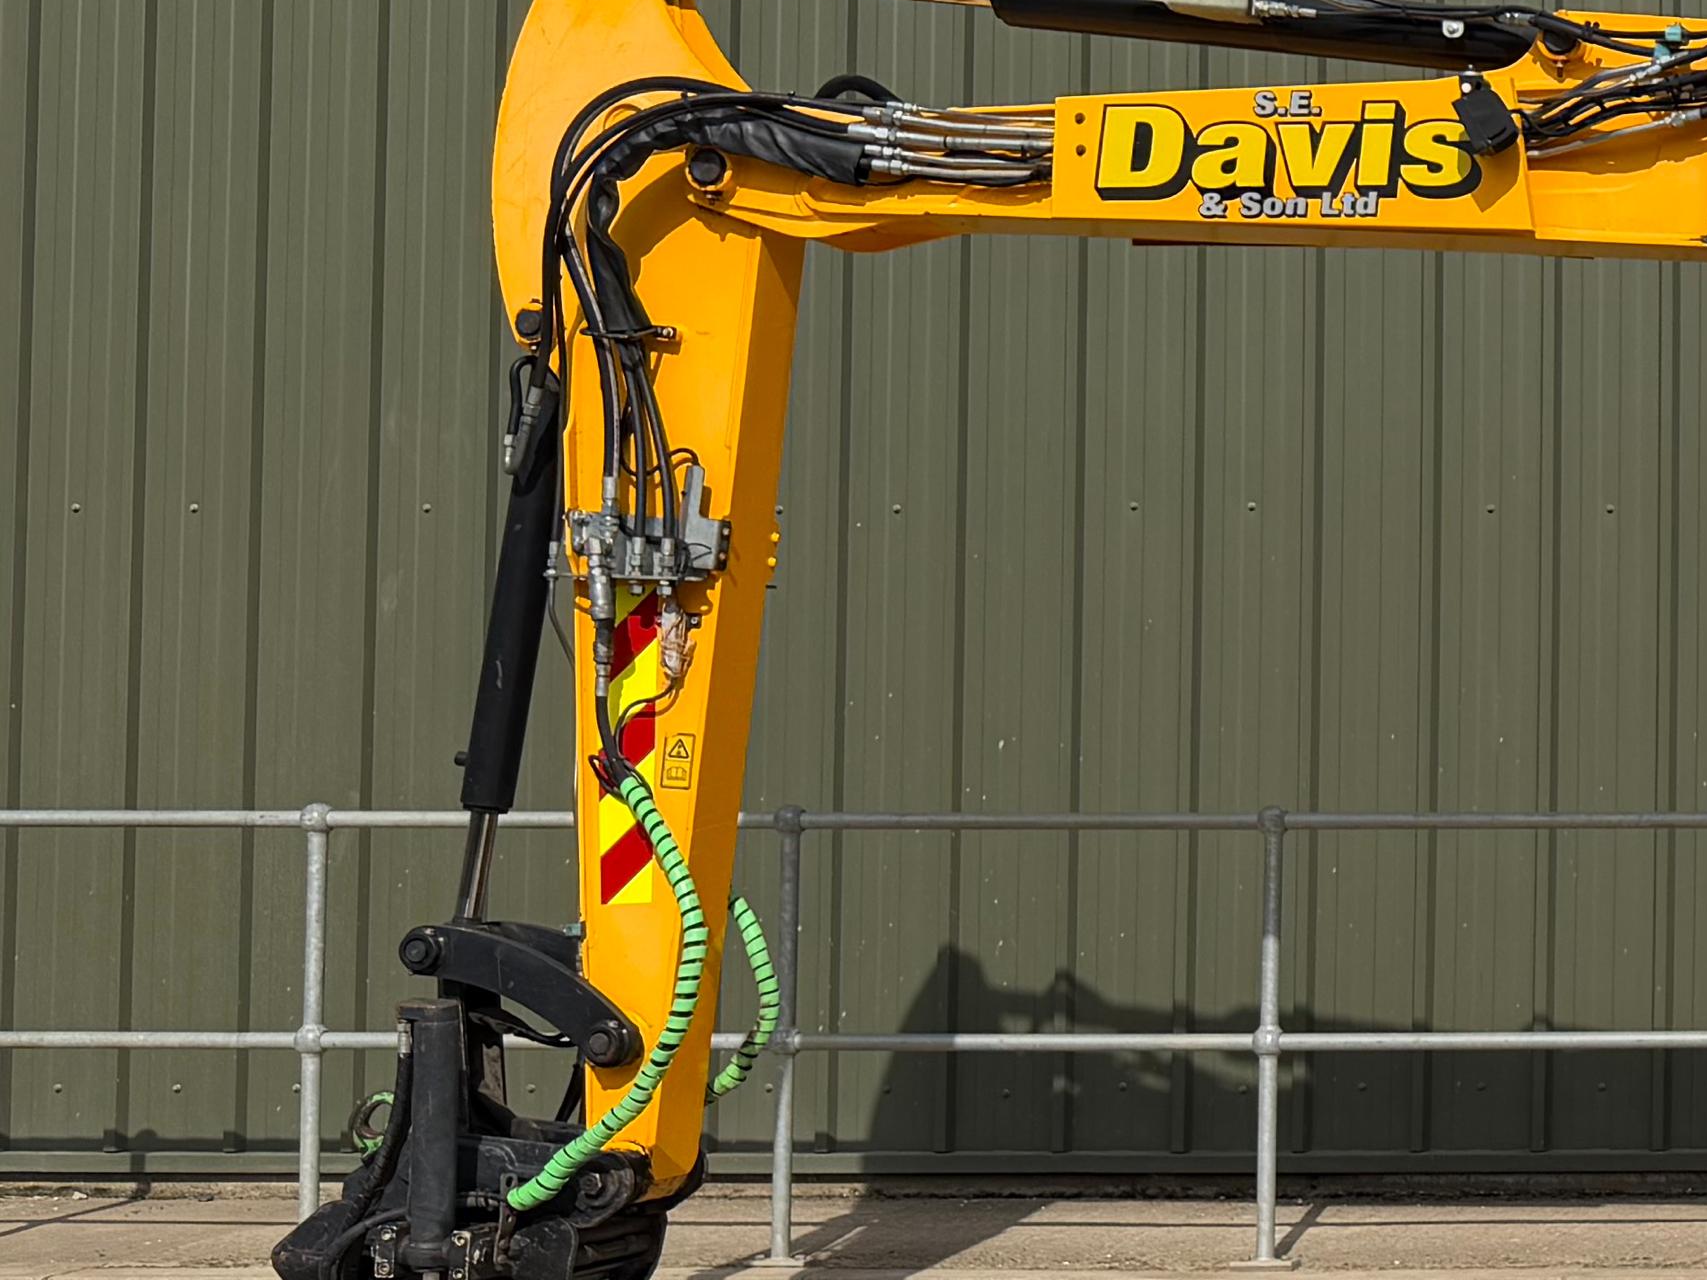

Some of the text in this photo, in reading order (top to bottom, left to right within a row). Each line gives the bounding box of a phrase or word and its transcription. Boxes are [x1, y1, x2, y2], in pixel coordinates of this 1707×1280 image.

[1253, 91, 1323, 118] S.E.
[1095, 100, 1483, 201] Davis
[1199, 191, 1380, 219] & Son Ltd
